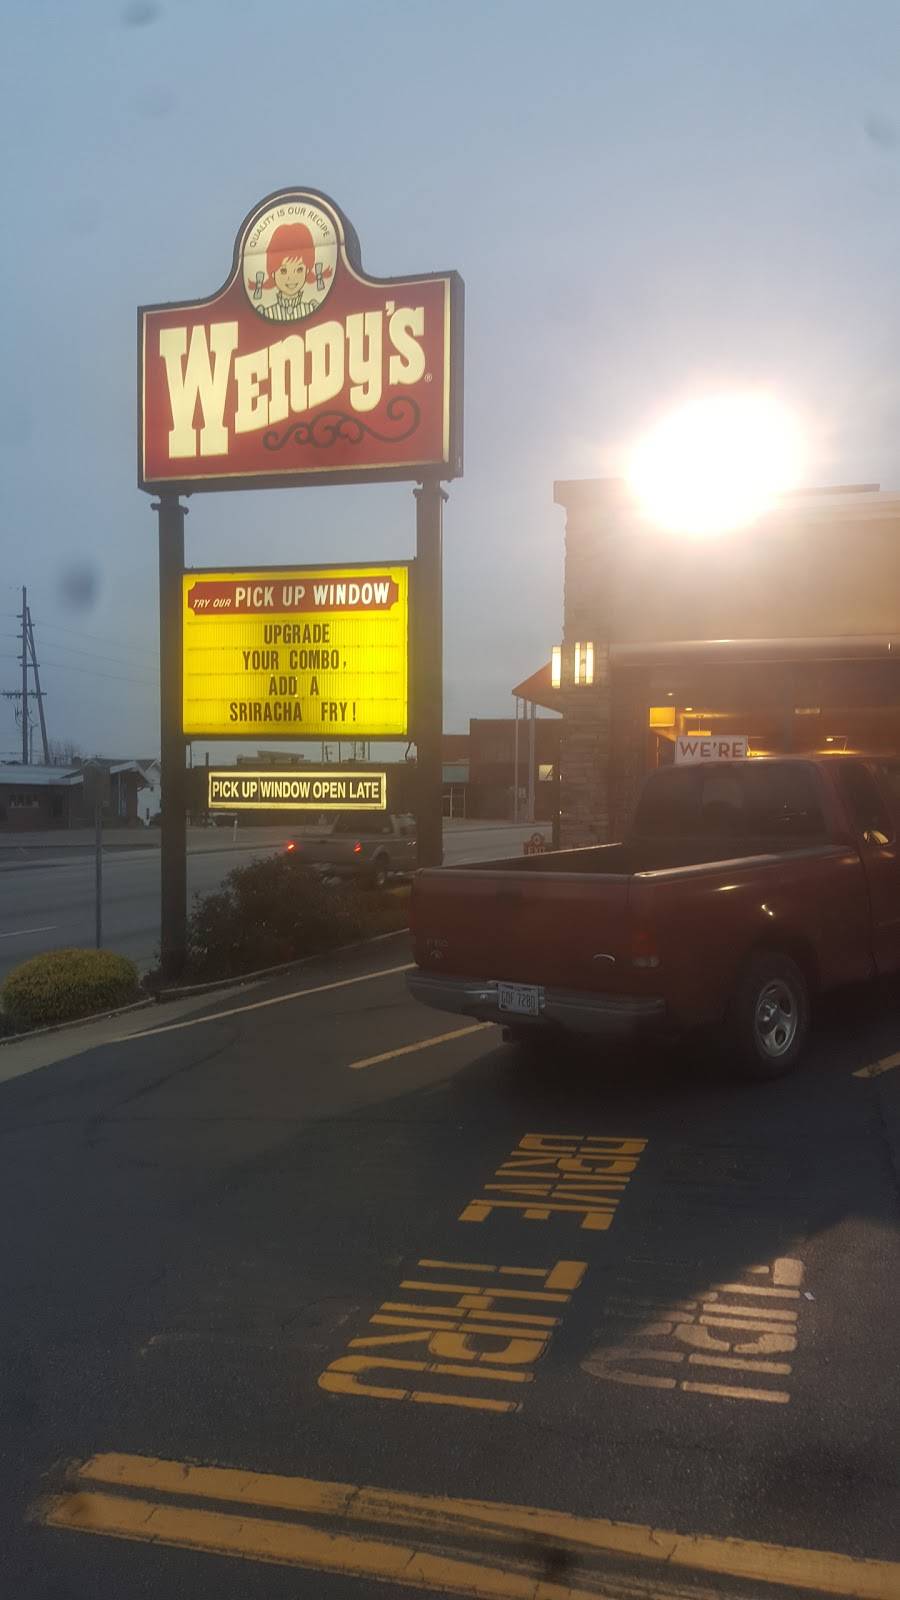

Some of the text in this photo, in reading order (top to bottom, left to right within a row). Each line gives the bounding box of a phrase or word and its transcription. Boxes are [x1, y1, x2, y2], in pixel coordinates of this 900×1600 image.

[249, 206, 330, 248] QUALITY IS OUR RECIPE
[193, 582, 390, 609] TRY OUR PICK UP WINDOW
[264, 624, 330, 644] UPGRADE
[243, 651, 279, 670] YOUR
[269, 676, 320, 696] ADD A
[230, 702, 356, 721] SRIRACHA FRY!
[680, 742, 744, 758] WE'RE
[212, 781, 379, 798] PICK UP WINDOW OPEN LATE
[318, 1133, 648, 1412] DRIVE THRU
